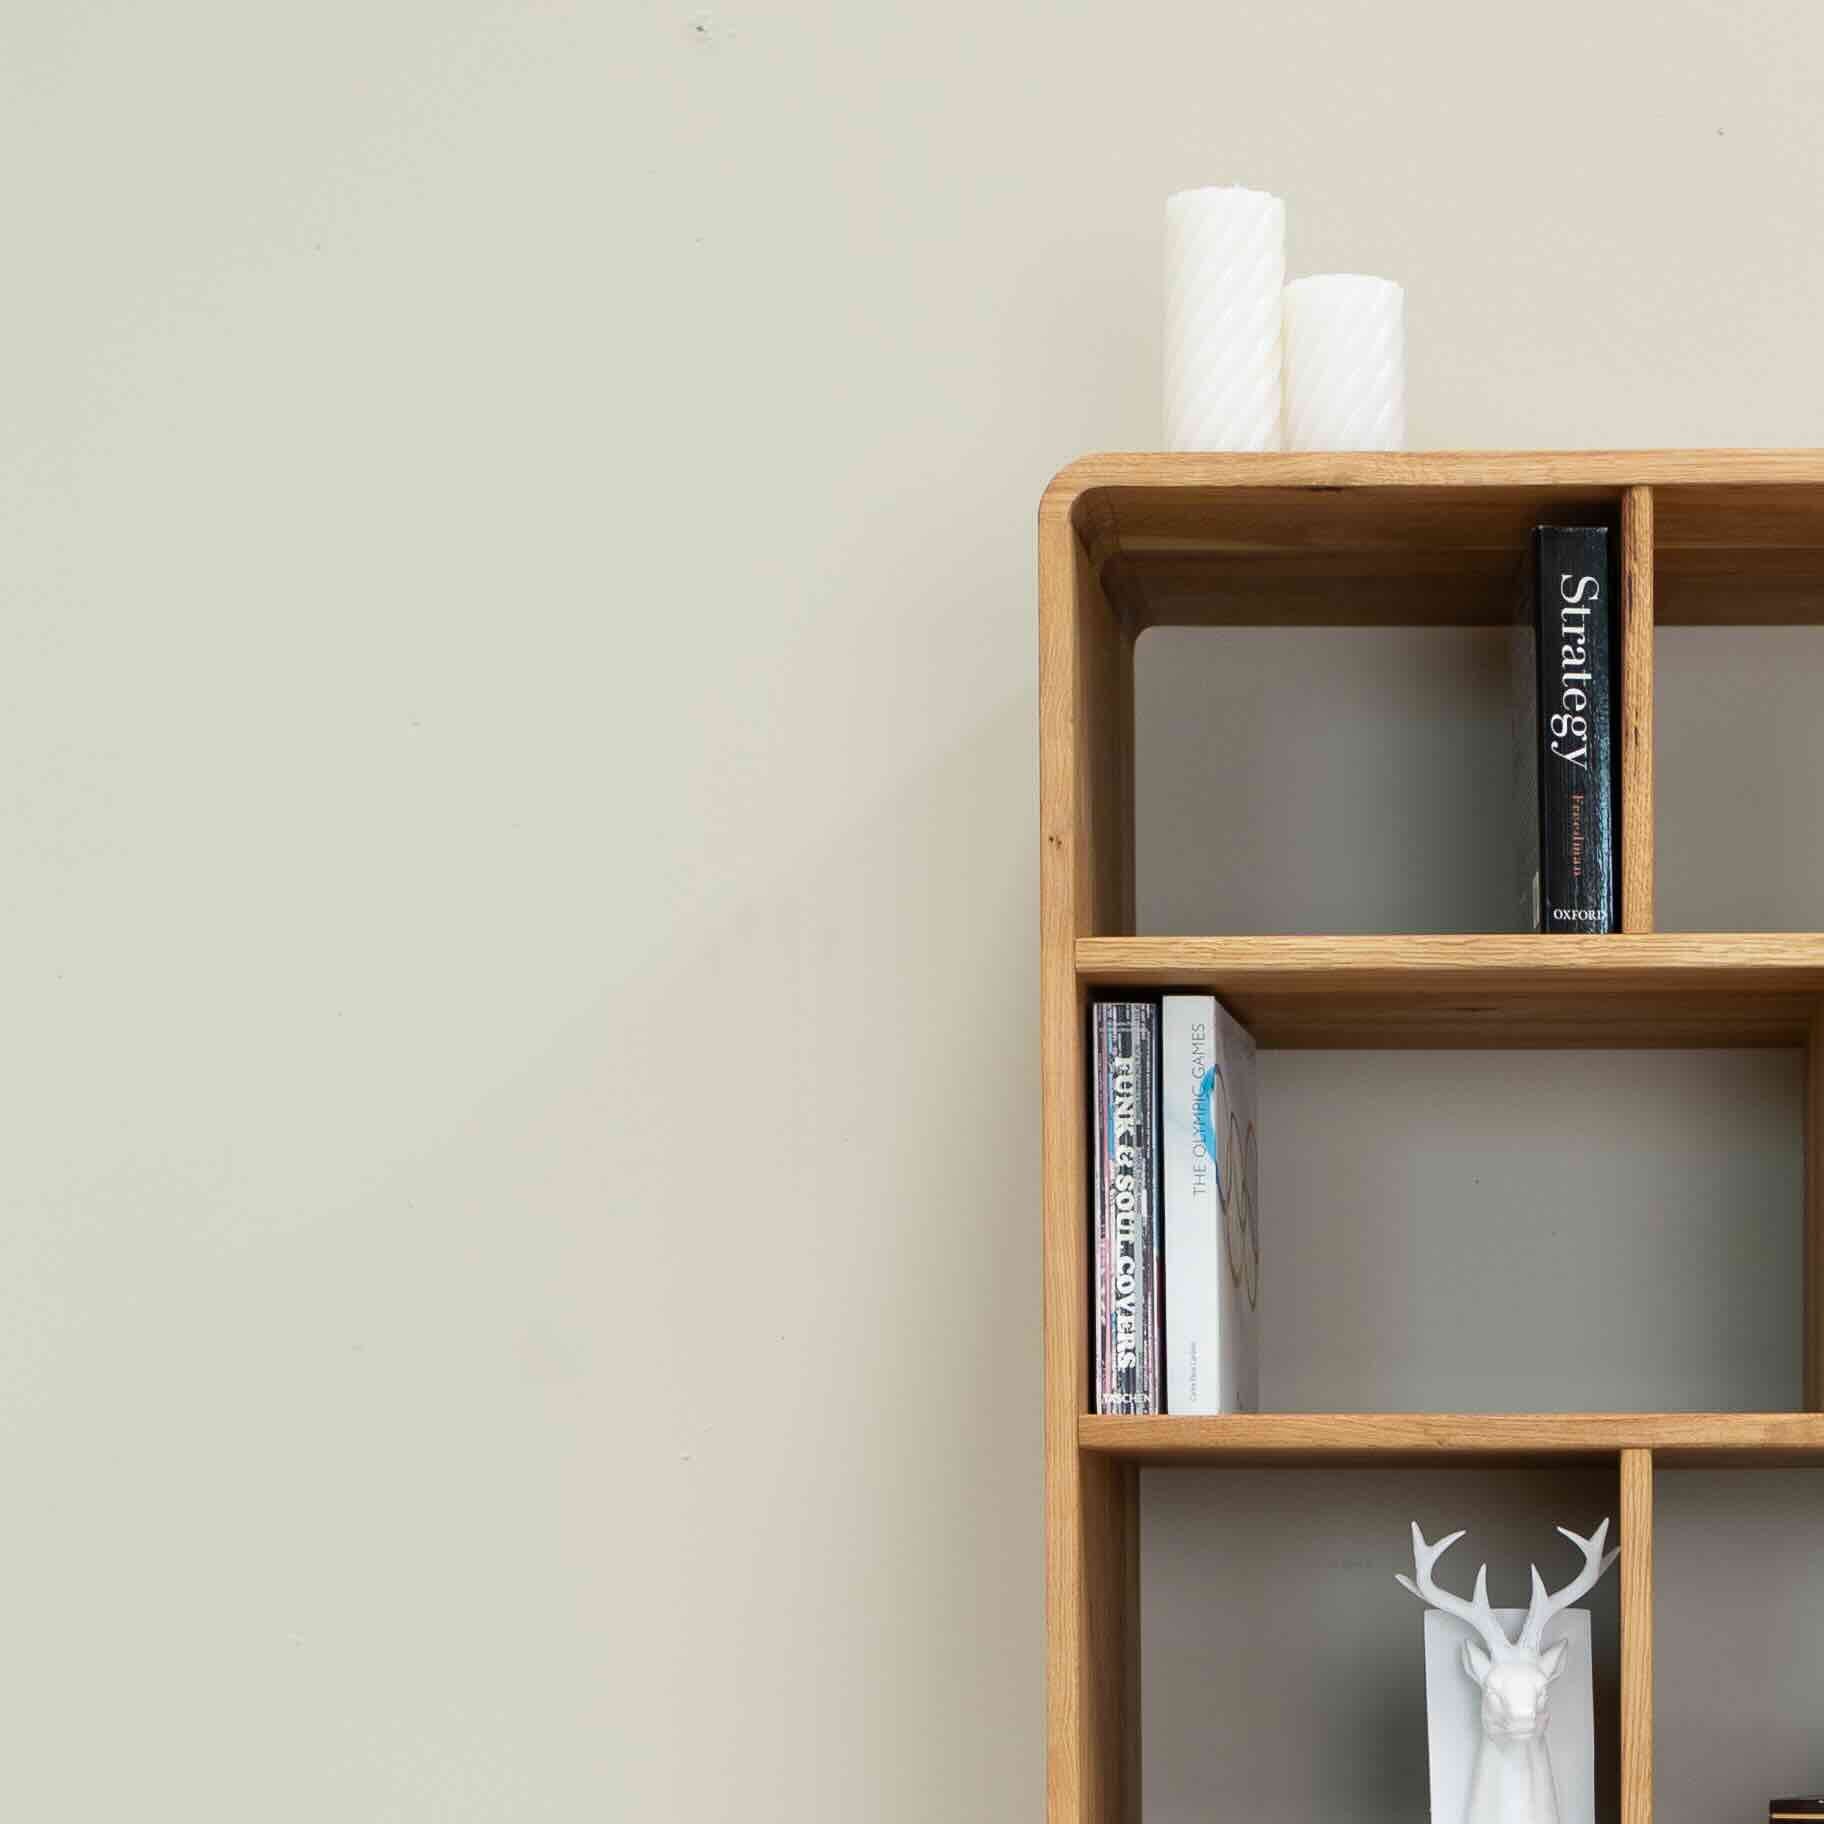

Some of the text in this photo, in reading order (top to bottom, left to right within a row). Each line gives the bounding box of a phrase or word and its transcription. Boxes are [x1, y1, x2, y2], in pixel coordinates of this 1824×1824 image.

[1551, 574, 1600, 771] Strategy
[1553, 908, 1607, 921] OXFORD
[1191, 1023, 1207, 1196] THE OLYMPIC GAMES
[1115, 1057, 1137, 1369] FUNK & SOUL COVERS
